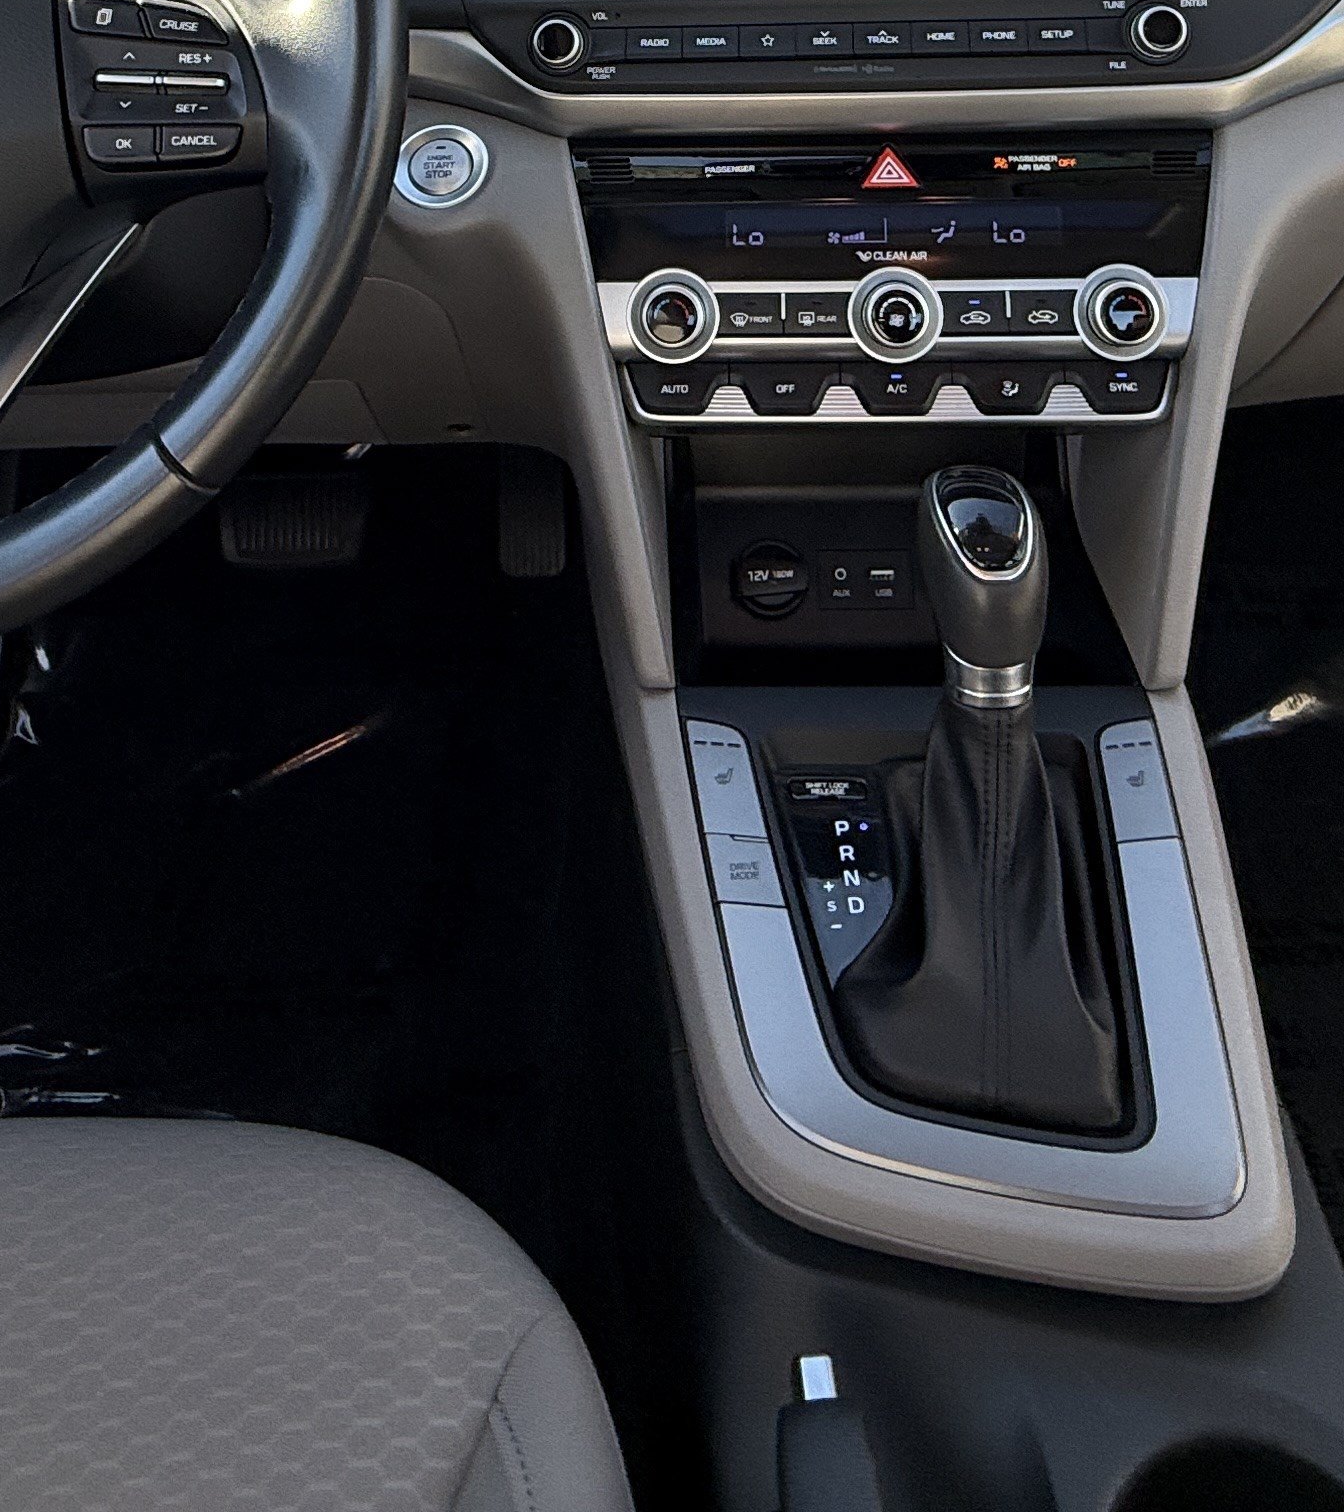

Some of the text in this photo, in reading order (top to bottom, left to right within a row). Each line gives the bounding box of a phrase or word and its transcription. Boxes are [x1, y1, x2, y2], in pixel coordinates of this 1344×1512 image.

[1102, 0, 1126, 10] TUNE
[591, 11, 608, 21] VOL
[159, 18, 200, 33] CRUISE
[926, 31, 955, 41] HOME
[982, 30, 1016, 41] PHONE
[1041, 29, 1074, 39] SETUP
[640, 38, 670, 47] RADIO
[696, 37, 727, 47] MEDIA
[812, 37, 837, 46] SEEK
[867, 34, 899, 45] TRACK
[586, 66, 616, 74] POWER
[1109, 60, 1127, 70] FILE
[115, 138, 133, 150] OK
[171, 135, 218, 147] CANCEL
[423, 161, 456, 170] START
[1058, 158, 1078, 168] OFF
[425, 170, 453, 179] STOP
[732, 223, 765, 247] Lo
[992, 220, 1026, 244] Lo
[873, 250, 928, 262] CLEAN AIR
[749, 314, 773, 324] FRONT
[816, 314, 837, 324] REAR
[660, 383, 689, 395] AUTO
[775, 383, 795, 395] OFF
[886, 383, 908, 395] A/C
[1109, 382, 1138, 393] SYNC
[748, 569, 769, 582] 12V
[832, 589, 851, 597] AUX
[834, 820, 850, 836] P
[839, 845, 856, 862] R
[729, 861, 759, 871] DRIVE
[730, 871, 759, 881] MODE
[843, 869, 861, 887] N
[827, 896, 865, 914] S D
